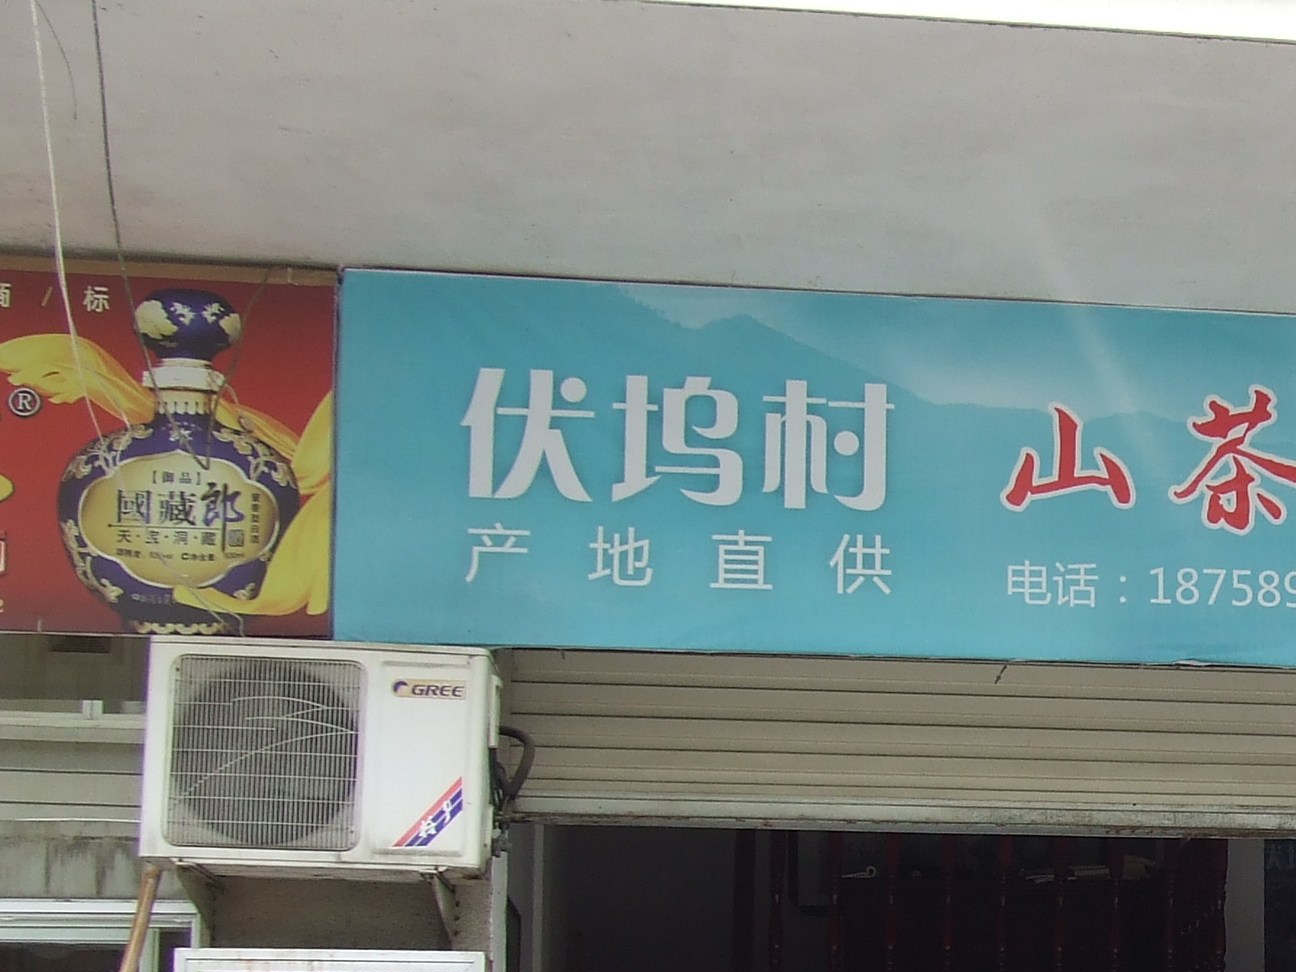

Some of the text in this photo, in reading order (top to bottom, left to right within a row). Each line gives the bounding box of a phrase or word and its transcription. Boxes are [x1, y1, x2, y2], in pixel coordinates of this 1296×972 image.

[460, 367, 895, 512] 伏坞村
[465, 522, 894, 596] 产地直供
[411, 683, 465, 698] GREE
